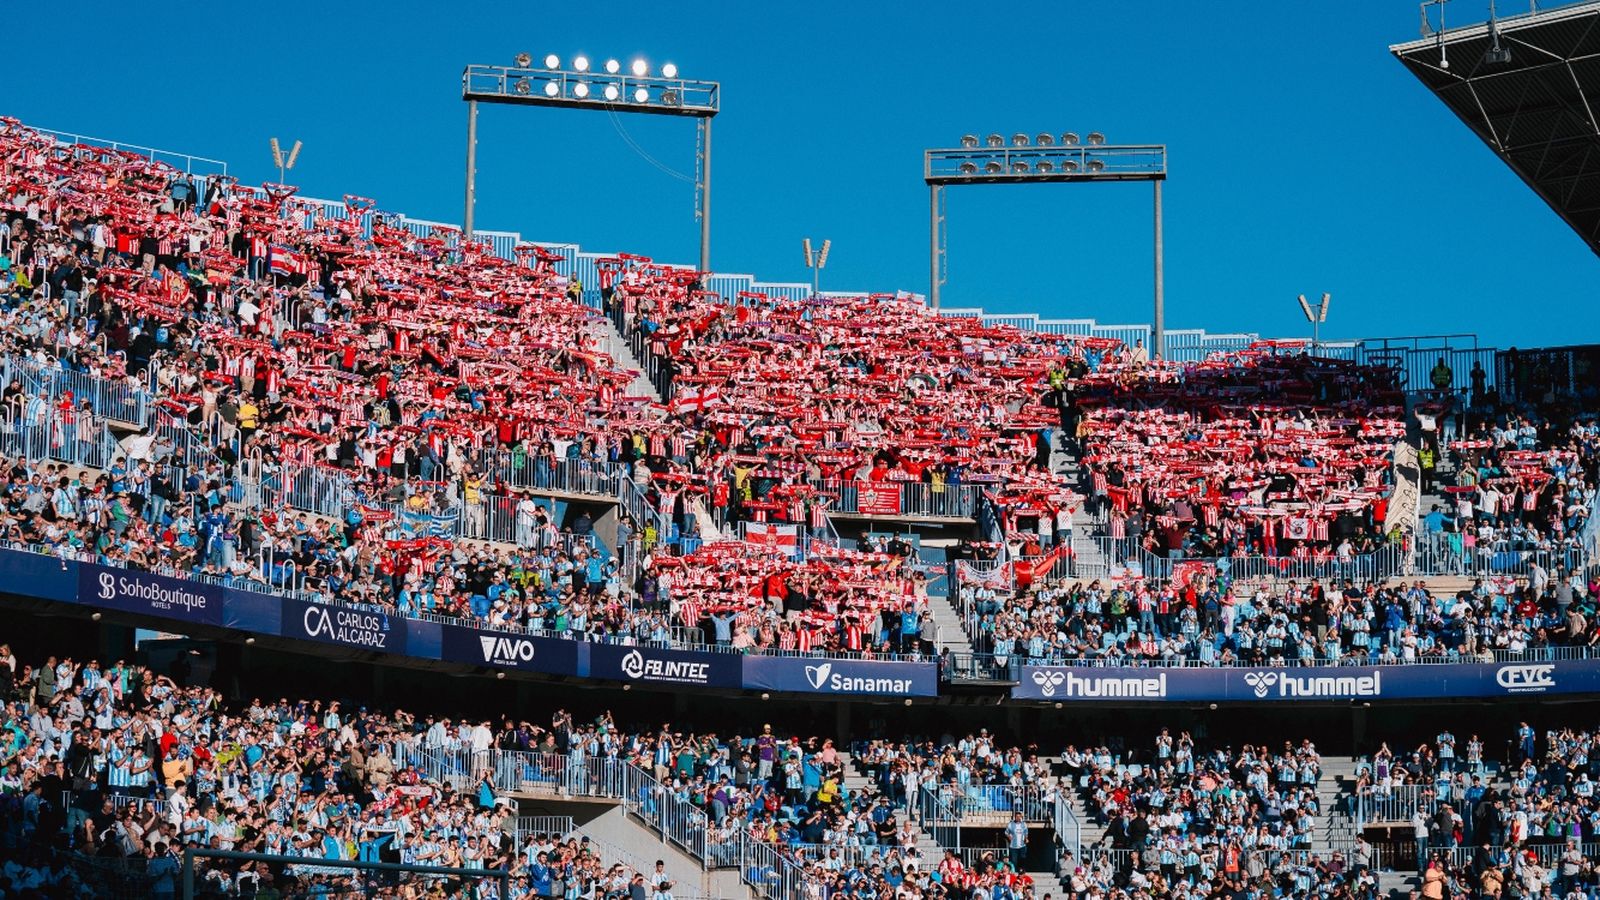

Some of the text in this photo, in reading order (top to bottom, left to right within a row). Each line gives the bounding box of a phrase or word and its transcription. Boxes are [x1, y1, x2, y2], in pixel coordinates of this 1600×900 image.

[119, 577, 206, 611] SohoBoutique
[337, 611, 380, 631] CARLOS
[336, 627, 386, 648] ALCARAZ
[830, 672, 912, 693] Sanamar
[1067, 672, 1166, 696] hummel
[1279, 670, 1381, 696] hummel
